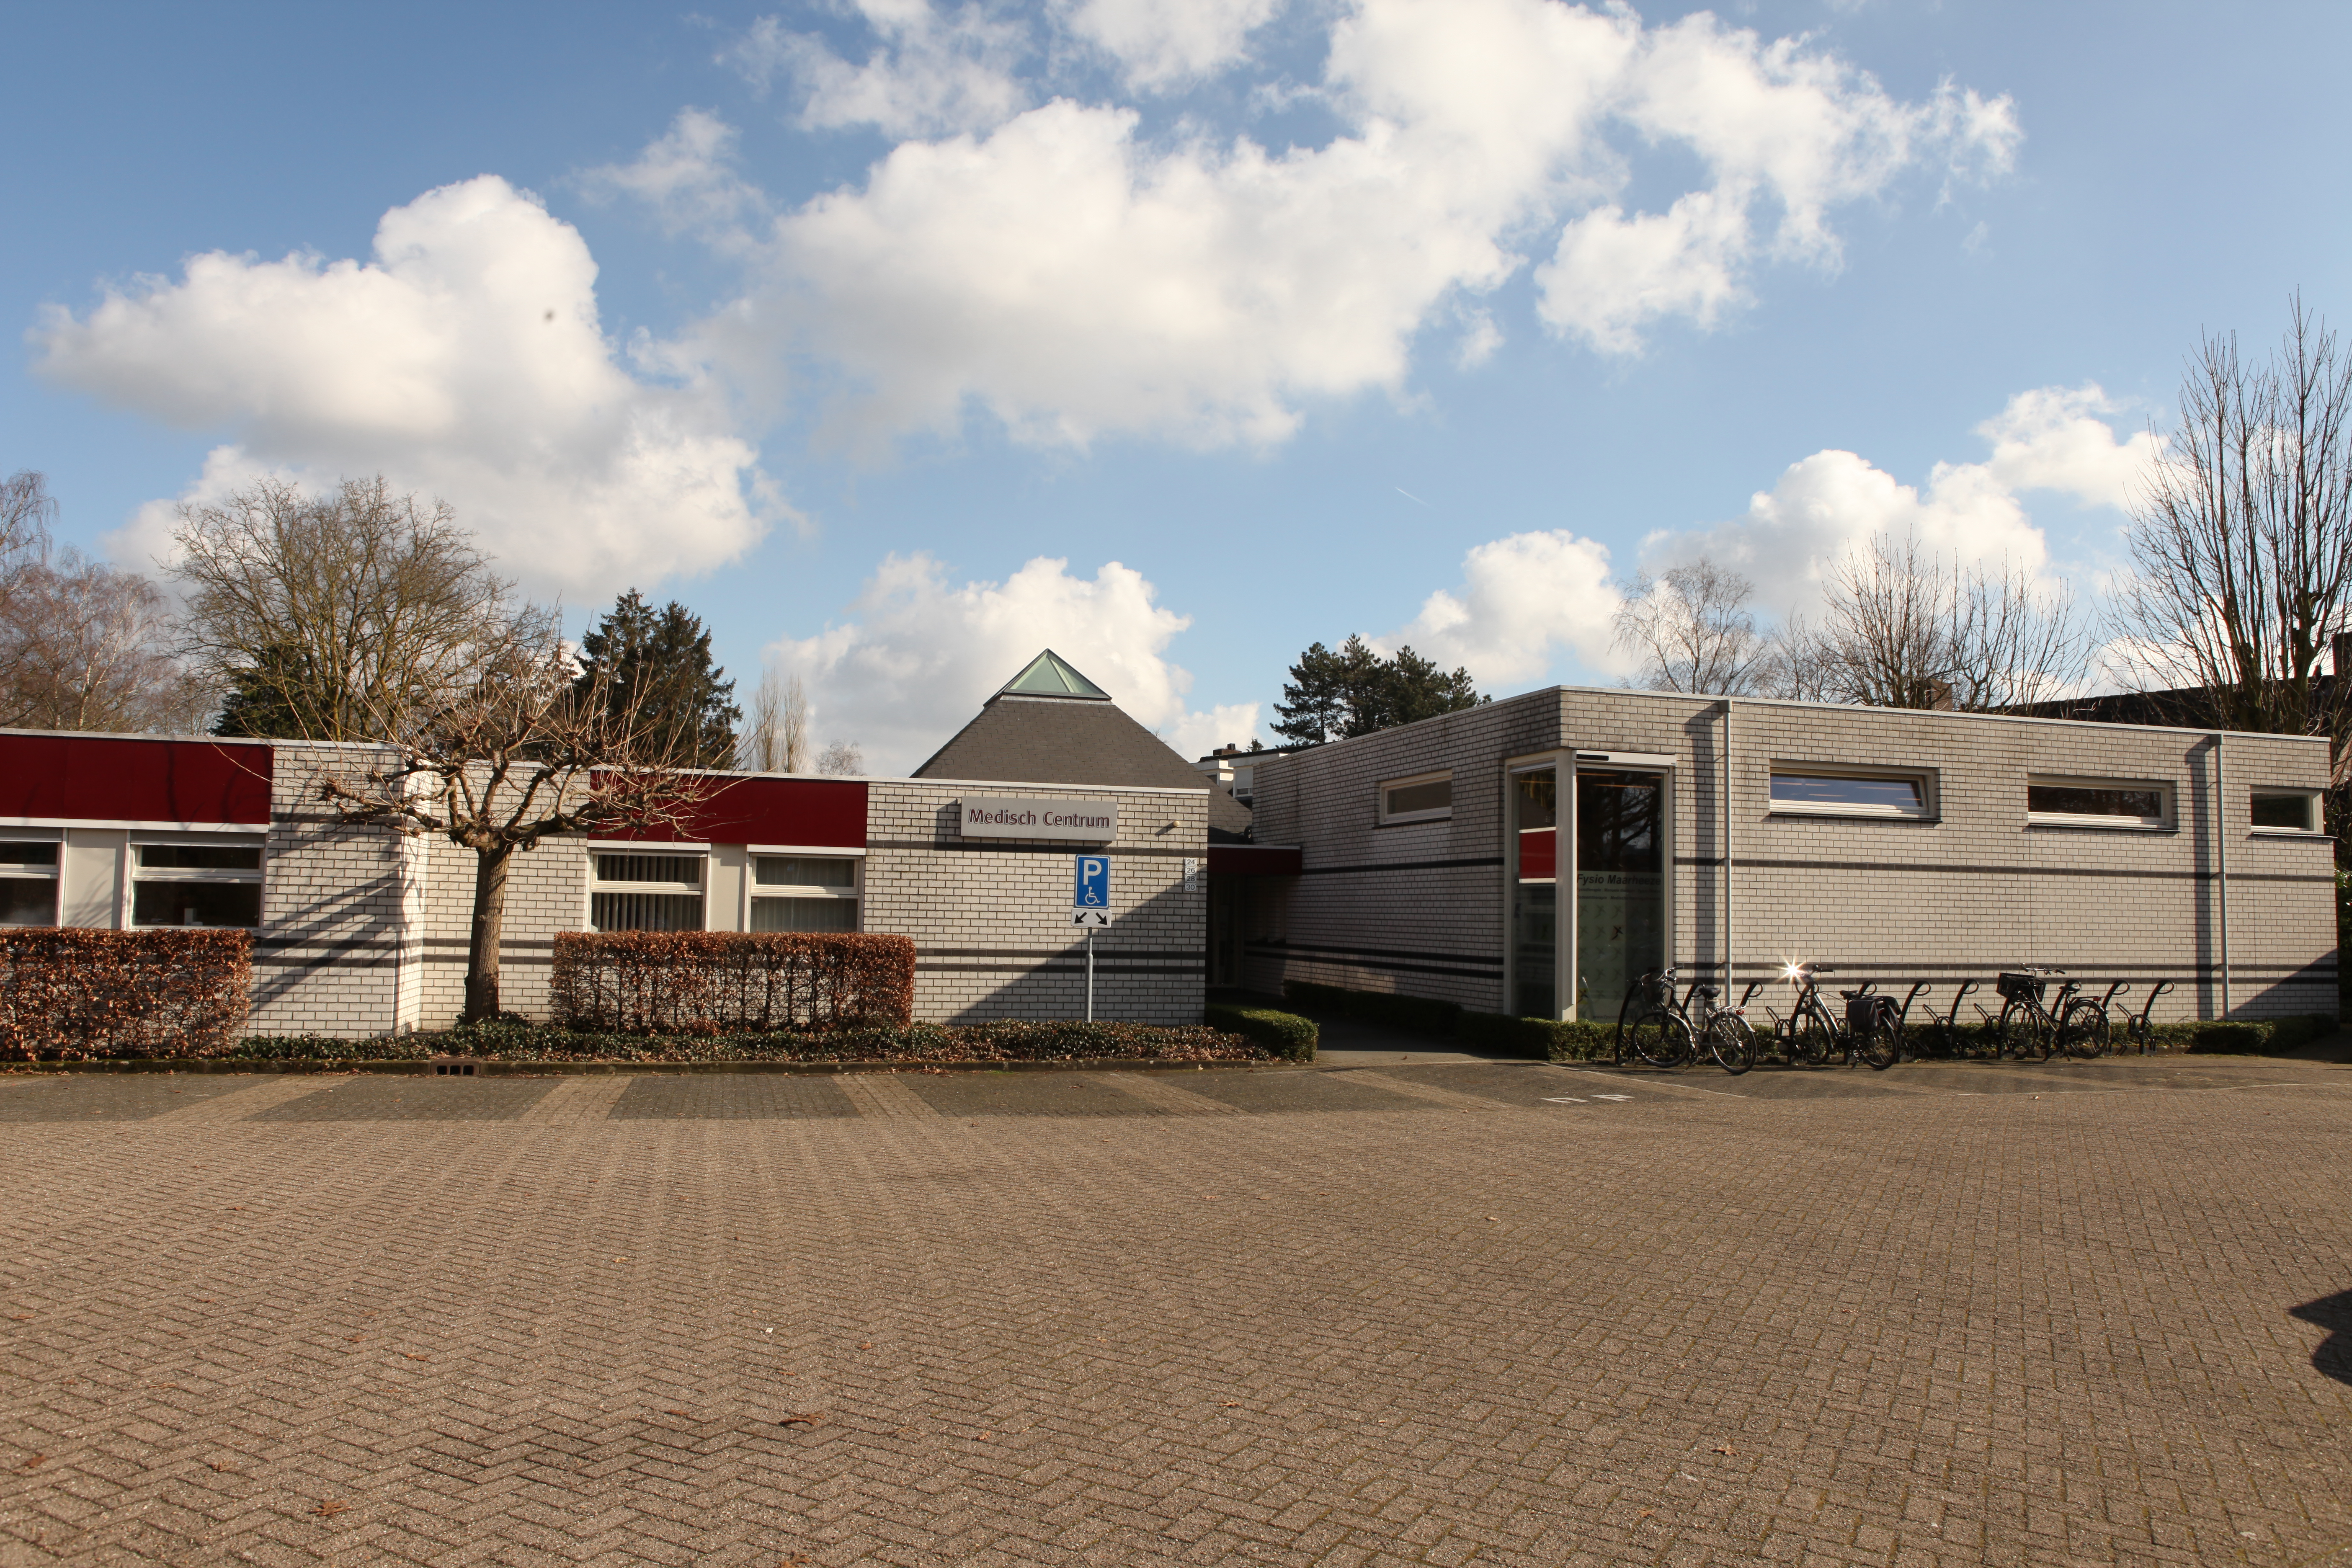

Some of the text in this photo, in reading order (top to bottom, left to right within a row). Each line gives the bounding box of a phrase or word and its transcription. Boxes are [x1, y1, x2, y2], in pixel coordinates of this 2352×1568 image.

[969, 808, 1110, 828] Medisch Centrum
[1083, 859, 1102, 885] P
[1577, 874, 1661, 886] Fysio Maarheeze
